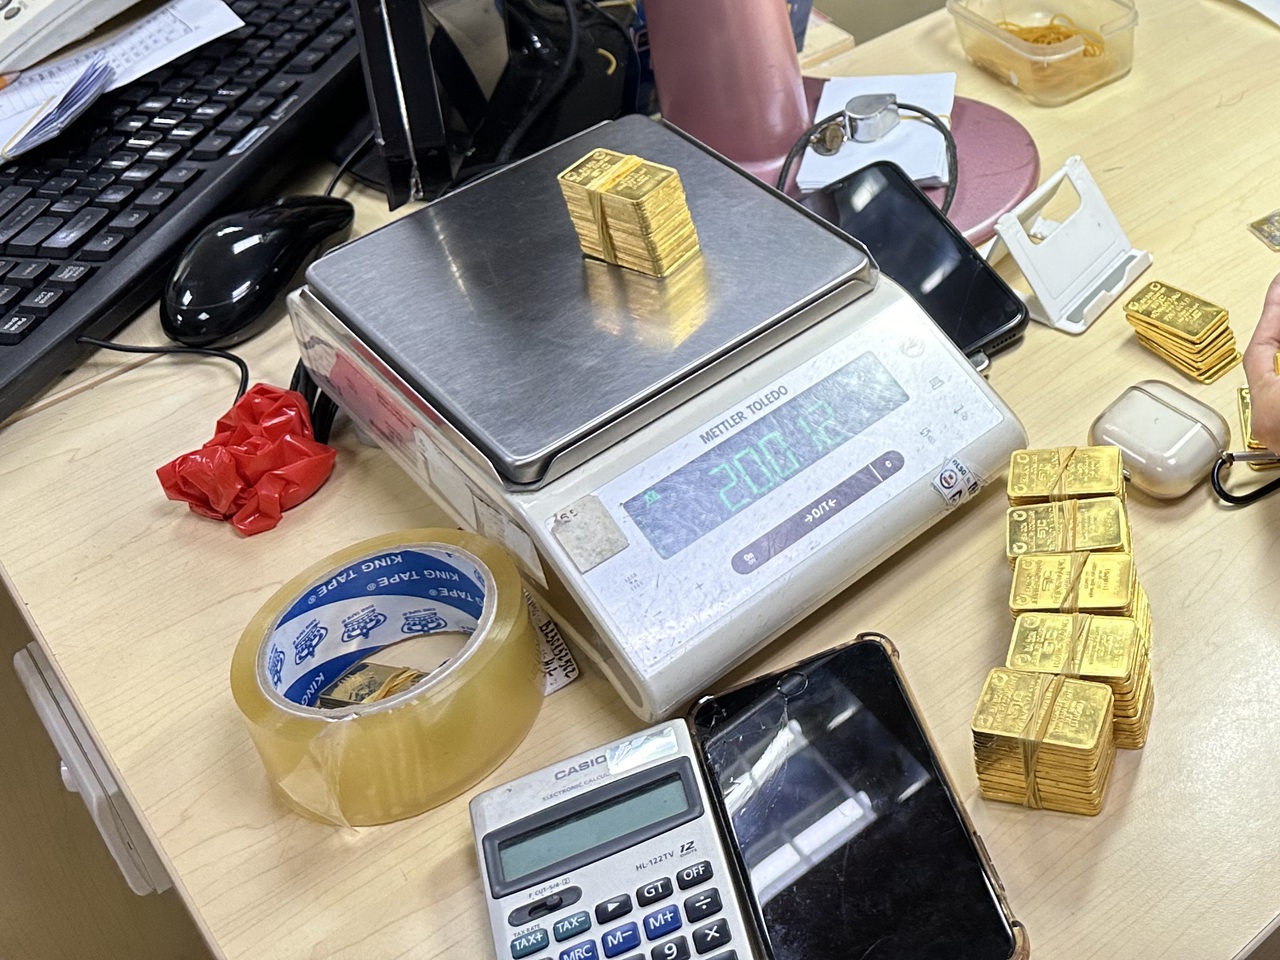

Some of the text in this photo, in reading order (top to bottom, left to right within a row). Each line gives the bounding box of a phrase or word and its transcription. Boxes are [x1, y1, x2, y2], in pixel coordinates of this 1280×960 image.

[700, 384, 789, 445] METTLER TOLEDO
[361, 554, 403, 573] KING
[423, 569, 460, 582] KING
[301, 672, 325, 707] KING
[554, 754, 607, 781] CASIO
[542, 772, 611, 802] ELECTRONIC CALCUL
[635, 850, 675, 871] HL-122TV
[683, 863, 705, 880] OFF
[644, 880, 664, 897] GT
[648, 910, 674, 930] M+
[513, 933, 543, 951] TAX+
[664, 942, 678, 960] 9
[563, 944, 593, 960] MRC
